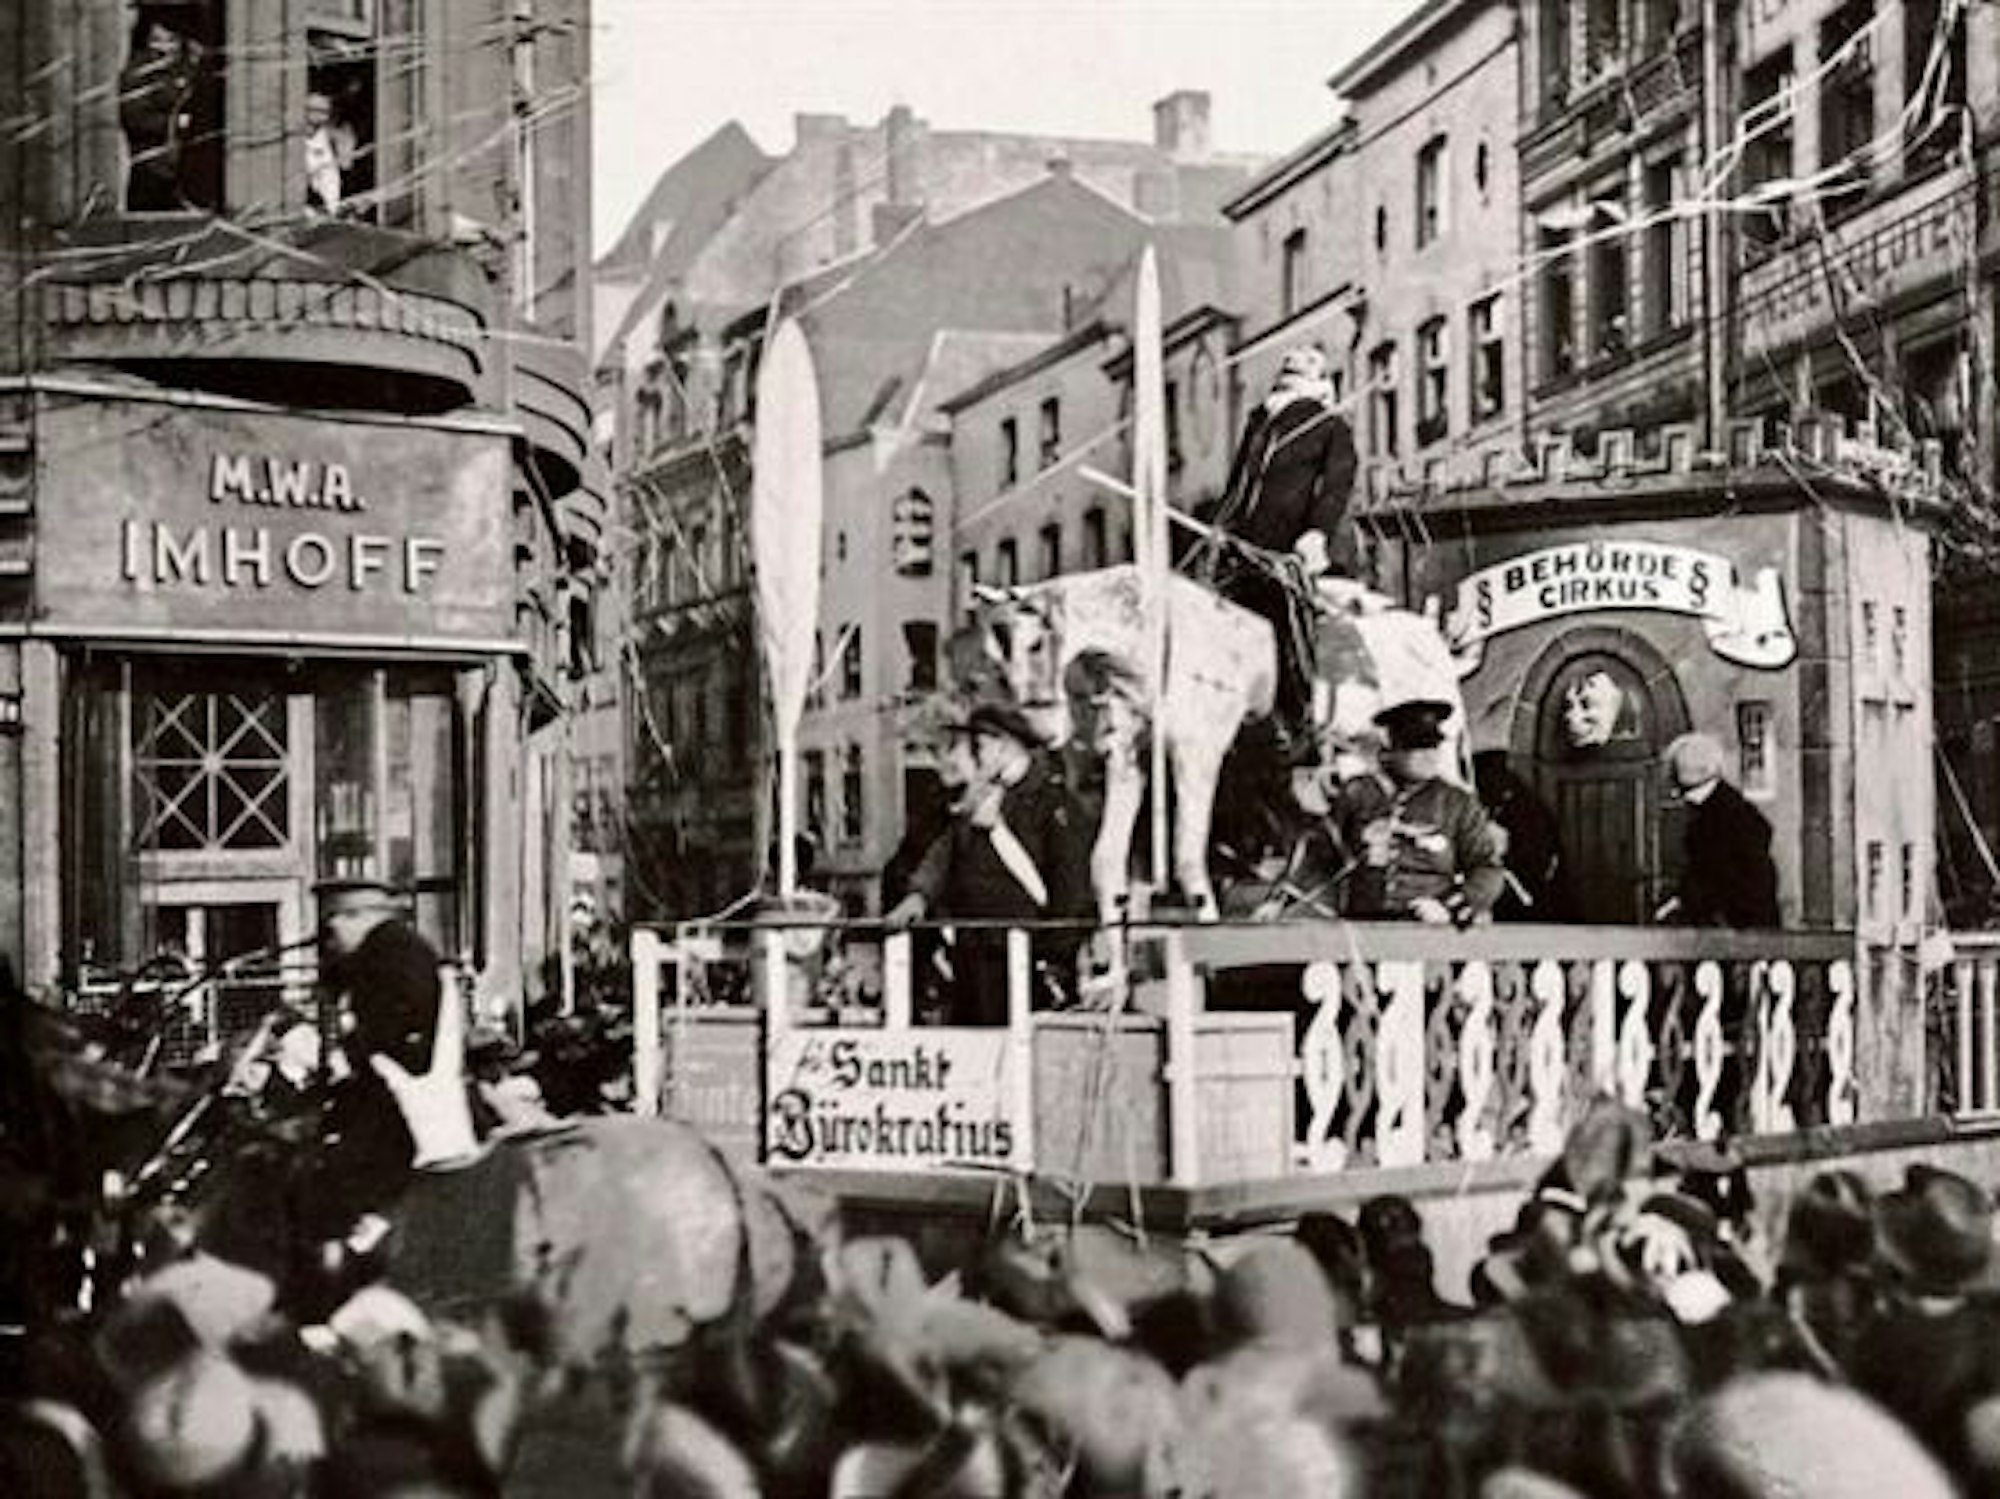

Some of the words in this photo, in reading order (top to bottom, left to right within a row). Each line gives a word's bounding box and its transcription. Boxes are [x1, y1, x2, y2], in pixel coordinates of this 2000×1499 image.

[209, 454, 366, 512] M.W.A.
[121, 519, 446, 594] IMHOFF
[1504, 541, 1679, 592] BEHÖRDE
[1537, 578, 1661, 610] CIRKUS
[830, 1039, 952, 1089] Sankt
[768, 1087, 1014, 1161] Bürokratius
